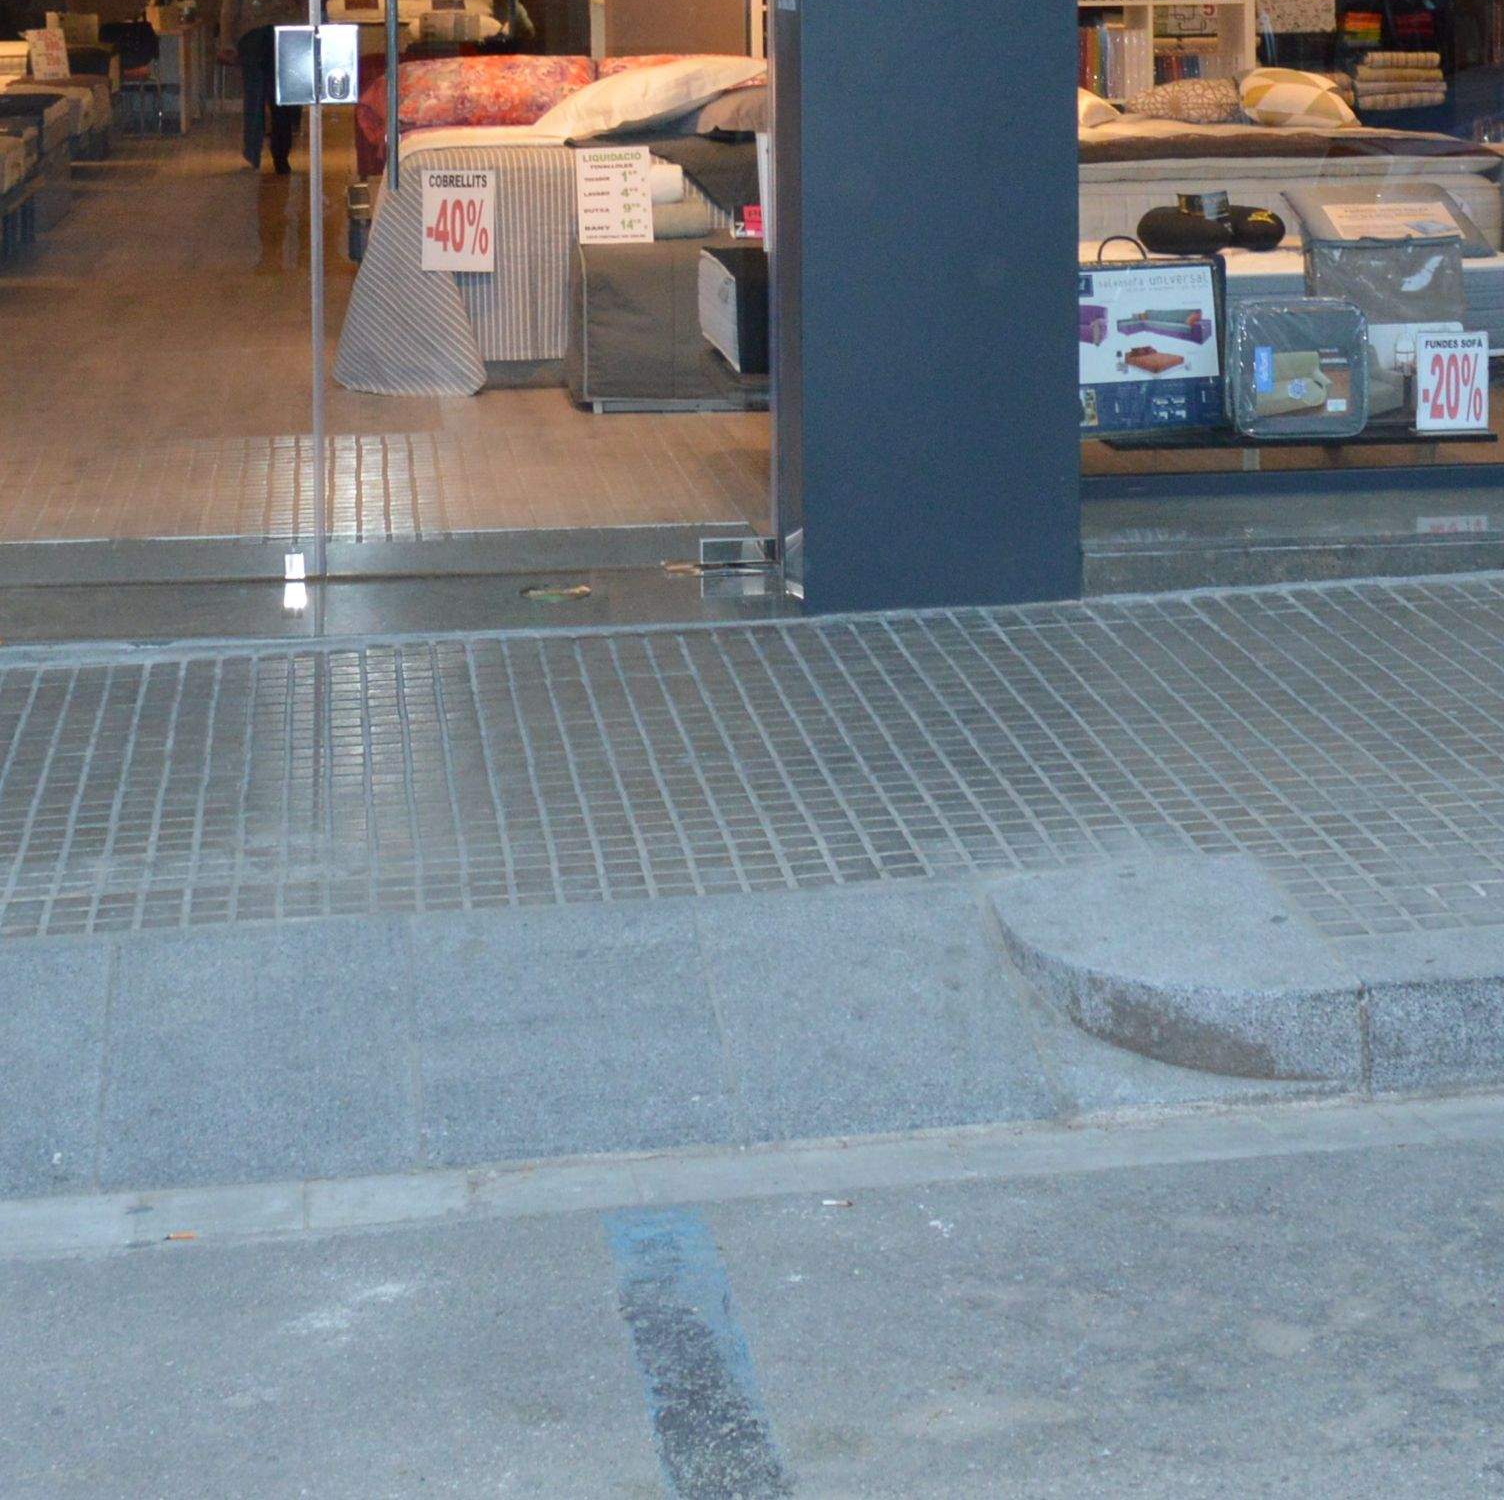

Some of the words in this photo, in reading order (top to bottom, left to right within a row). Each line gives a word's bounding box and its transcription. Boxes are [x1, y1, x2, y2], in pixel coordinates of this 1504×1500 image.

[428, 174, 488, 189] COBRELLITS
[426, 198, 489, 256] -40%
[1424, 339, 1459, 349] FUNDES
[1422, 352, 1483, 422] -20%
